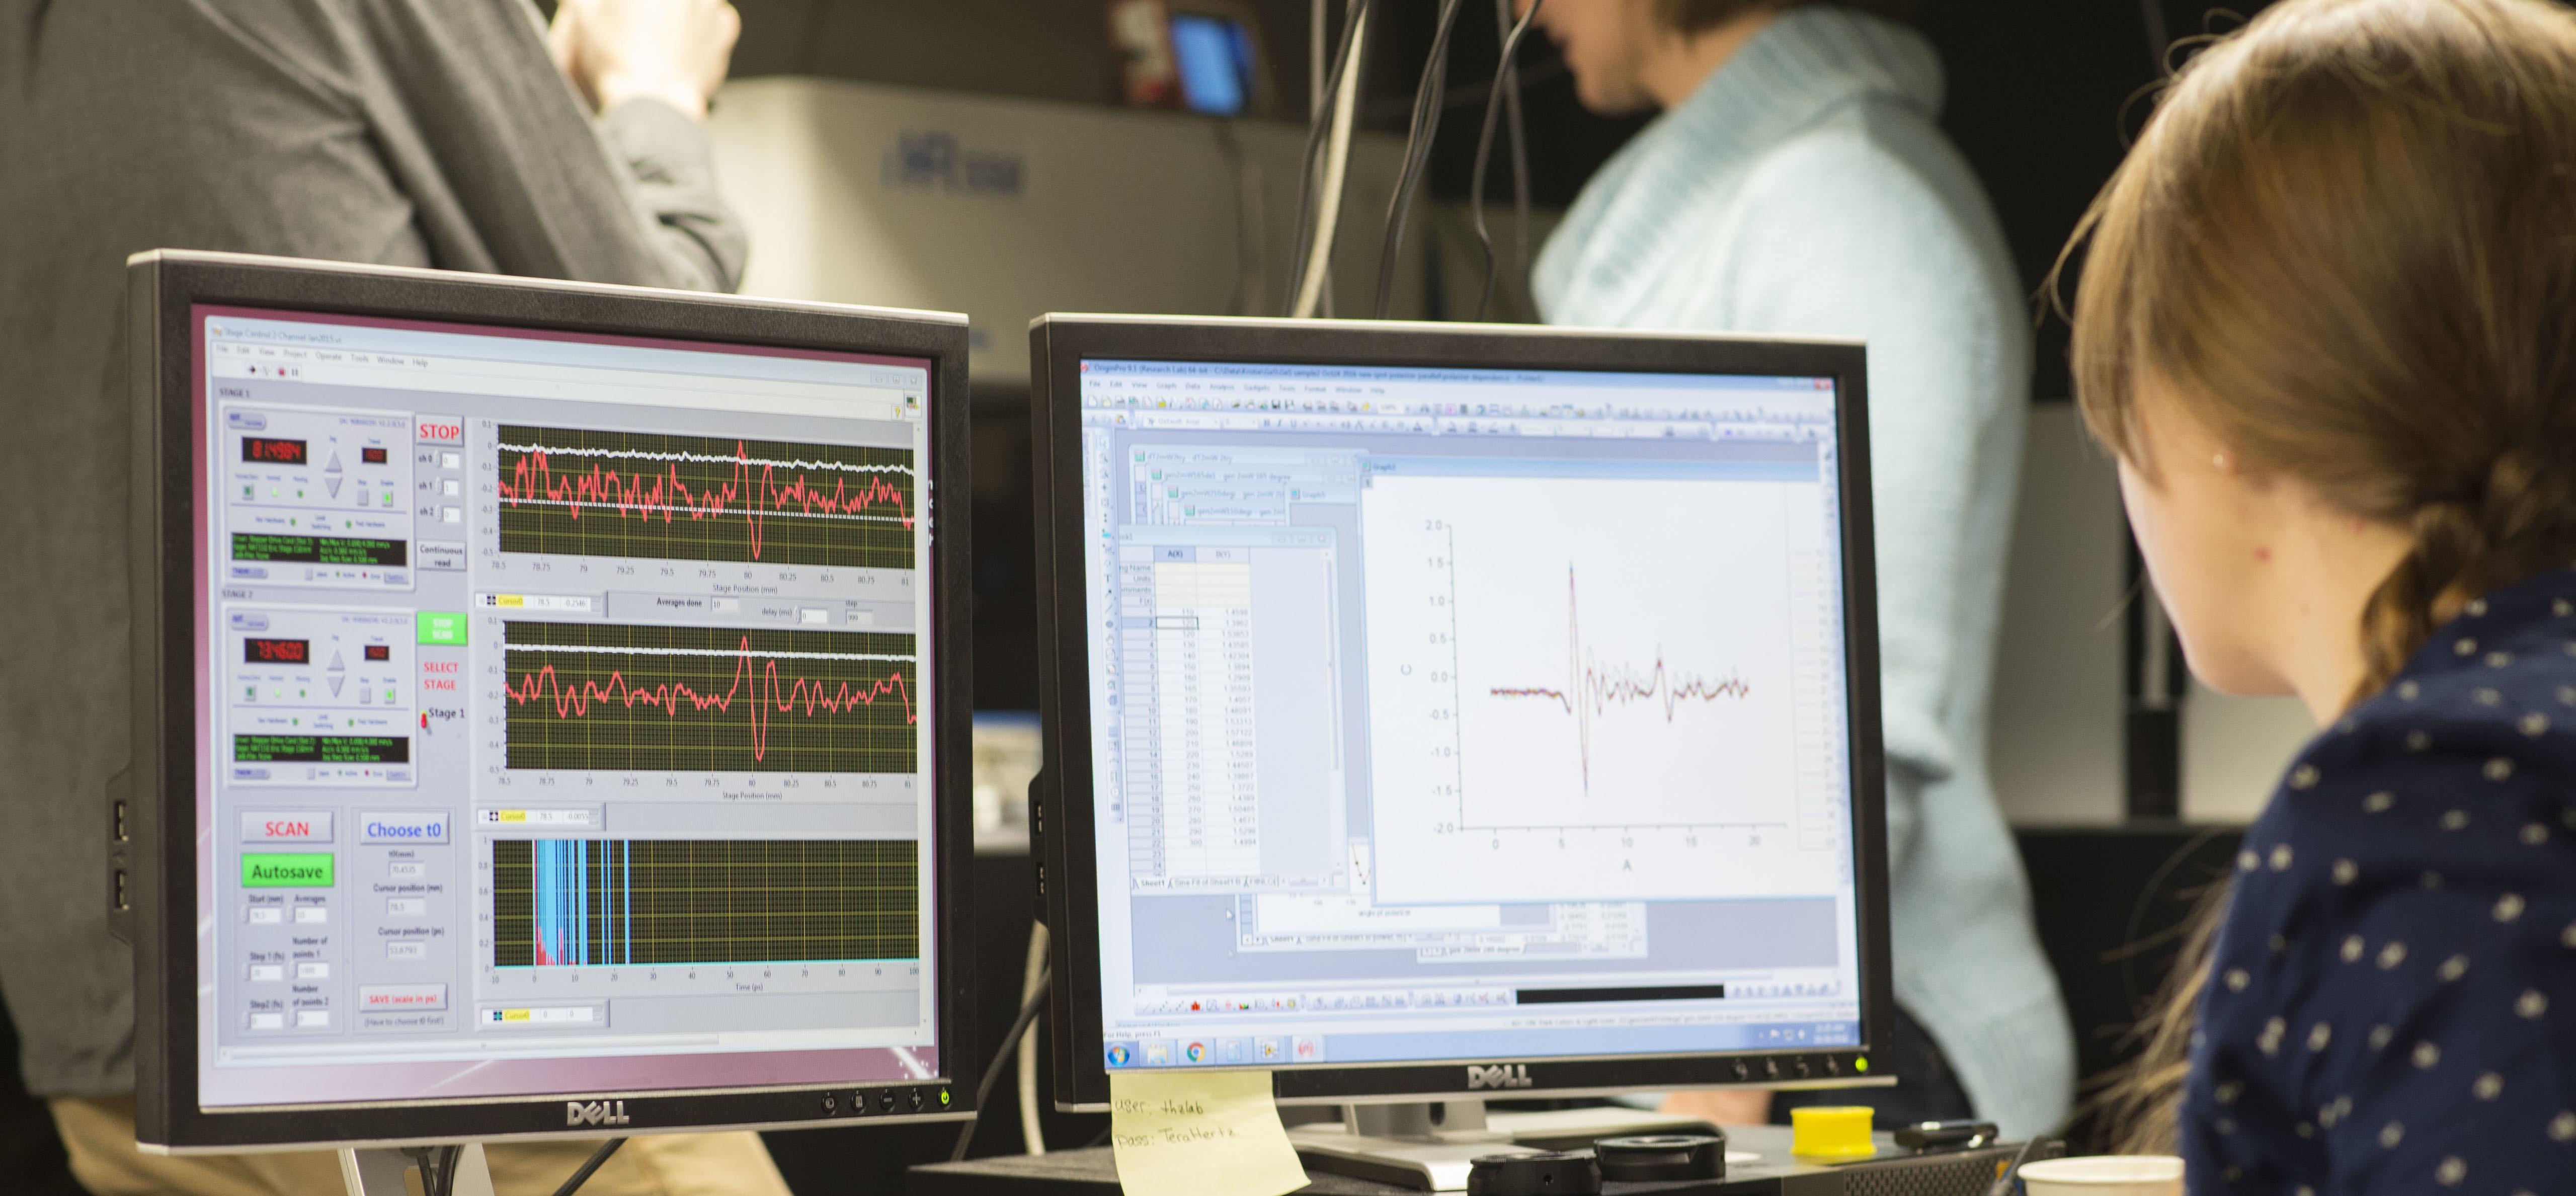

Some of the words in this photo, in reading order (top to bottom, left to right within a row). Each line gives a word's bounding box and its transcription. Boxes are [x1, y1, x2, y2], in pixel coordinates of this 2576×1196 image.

[420, 424, 459, 440] STOP
[1425, 520, 1442, 531] 2.0
[420, 544, 463, 555] Continuous
[434, 560, 451, 568] read
[1427, 558, 1444, 569] 1.5
[744, 572, 752, 580] 80
[713, 584, 732, 594] Stage
[734, 585, 759, 594] Position
[761, 586, 778, 596] (mm)
[656, 597, 686, 608] Averages
[687, 599, 702, 608] done
[845, 599, 858, 608] step
[1429, 596, 1445, 606] 1.0
[762, 607, 777, 617] delay
[779, 608, 792, 618] (ms)
[1430, 633, 1446, 644] 0.5
[424, 662, 458, 673] SELECT
[1431, 672, 1447, 682] 0.0
[424, 680, 456, 690] STAGE
[429, 707, 456, 720] Stage
[460, 708, 464, 718] 1
[722, 791, 739, 801] Stage
[741, 792, 764, 800] Position
[766, 792, 782, 801] (mm)
[266, 821, 309, 837] SCAN
[367, 822, 422, 838] Choose
[427, 823, 441, 837] t0
[1492, 838, 1499, 849] 0
[1558, 838, 1565, 849] 5
[1621, 837, 1633, 848] 10
[1749, 836, 1761, 846] 20
[1623, 859, 1632, 872] A
[252, 864, 323, 880] Autosave
[373, 884, 396, 892] Cursor
[249, 894, 265, 904] Start
[294, 894, 326, 906] Averages
[378, 927, 401, 935] Cursor
[292, 937, 318, 945] Number
[572, 974, 579, 982] 10
[610, 974, 618, 982] 20
[689, 972, 696, 980] 40
[910, 967, 919, 976] 100
[292, 985, 318, 993] Number
[736, 983, 751, 992] Time
[369, 995, 389, 1004] SAVE
[391, 995, 414, 1005] (scale
[416, 995, 423, 1003] in
[1468, 1064, 1533, 1090] DELL
[567, 1100, 629, 1127] DELL
